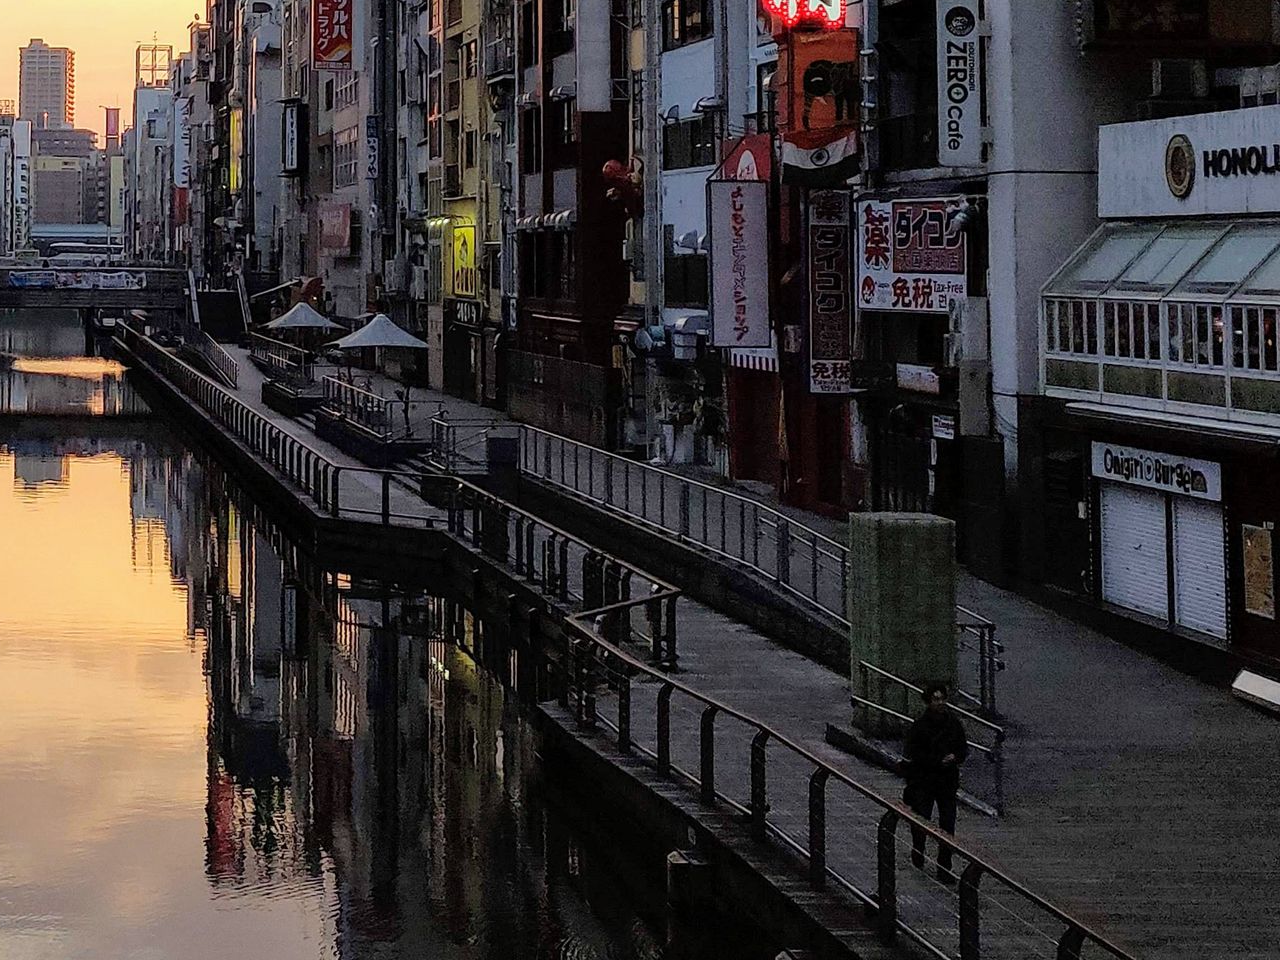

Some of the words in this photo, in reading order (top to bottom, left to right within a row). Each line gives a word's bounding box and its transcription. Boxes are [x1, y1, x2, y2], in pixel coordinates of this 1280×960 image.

[317, 2, 332, 51] ドラッグ
[946, 41, 969, 104] ZERO
[947, 106, 964, 152] cafe
[864, 203, 890, 270] 薬
[815, 227, 844, 313] ダイコク
[892, 277, 934, 309] 免税
[933, 281, 964, 293] Tax-Free
[812, 362, 850, 380] 免税
[1104, 448, 1144, 481] Onigiri
